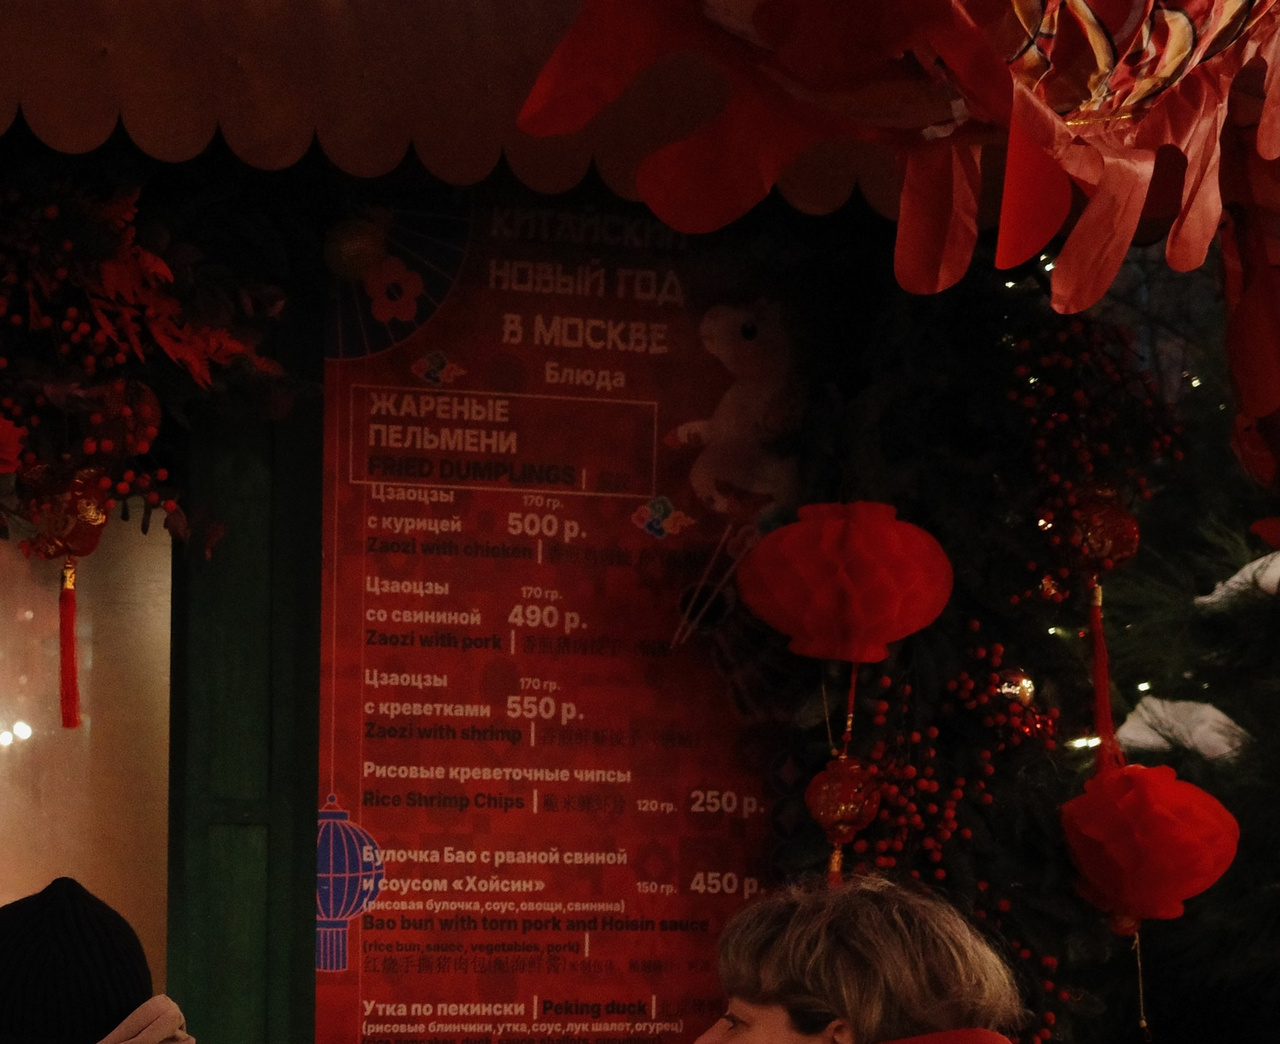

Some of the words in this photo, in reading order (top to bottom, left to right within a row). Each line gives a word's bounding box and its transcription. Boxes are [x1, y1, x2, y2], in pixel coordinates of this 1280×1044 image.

[488, 258, 606, 298] НОВЫЙ
[616, 268, 685, 307] ГОД
[503, 313, 522, 345] В
[534, 314, 669, 355] МОСКВЕ
[545, 361, 626, 391] Блюда
[370, 392, 510, 423] ЖАРЕНЫЕ
[368, 424, 518, 454] ПЕЛЬМЕНИ
[368, 454, 433, 479] FRIED
[439, 457, 575, 485] DUMPLINGS
[371, 484, 455, 504] Цзаоцзы
[523, 494, 544, 507] 170
[367, 516, 378, 529] с
[382, 515, 463, 535] курицей
[507, 511, 559, 538] 500
[564, 519, 588, 544] р.
[367, 536, 416, 554] Zaozi
[422, 539, 459, 556] with
[463, 541, 534, 559] chicken
[366, 575, 450, 597] Цзаоцзы
[521, 586, 543, 598] 170
[365, 609, 388, 622] со
[391, 607, 482, 625] свининой
[507, 604, 560, 629] 490
[565, 610, 588, 634] р.
[366, 629, 415, 646] Zaozi
[420, 631, 459, 648] with
[461, 634, 502, 652] pork
[364, 668, 449, 689] Цзаоцзы
[520, 677, 541, 690] 170
[364, 702, 375, 715] с
[379, 701, 492, 719] креветками
[506, 695, 557, 720] 550
[561, 701, 585, 725] р.
[365, 721, 414, 738] Zaozi
[419, 723, 457, 740] with
[461, 725, 523, 745] shrimp
[362, 761, 446, 780] Рисовые
[448, 766, 570, 784] креветочные
[573, 768, 632, 784] чипсы
[363, 790, 402, 807] Rice
[405, 790, 470, 812] Shrimp
[474, 792, 525, 812] Chips
[636, 799, 658, 812] 120
[690, 789, 738, 814] 250
[742, 796, 766, 818] р.
[362, 845, 440, 866] Булочка
[443, 846, 477, 864] Бао
[480, 850, 491, 863] с
[494, 847, 560, 867] рваной
[562, 848, 628, 865] свиной
[377, 878, 448, 896] соусом
[451, 875, 546, 892] «Хойсин»
[636, 881, 658, 894] 150
[689, 871, 739, 895] 450
[362, 898, 424, 913] (рисовая
[363, 915, 397, 930] Bao
[401, 915, 435, 931] bun
[439, 915, 478, 931] with
[481, 916, 519, 931] torn
[522, 917, 562, 934] pork
[566, 916, 598, 931] and
[602, 917, 656, 932] Hoisin
[659, 919, 710, 932] sauce
[363, 999, 408, 1017] Утка
[410, 1003, 434, 1016] по
[436, 1003, 526, 1017] пекински
[542, 1000, 602, 1019] Peking
[605, 1000, 648, 1016] duck
[362, 1021, 426, 1036] (рисовые
